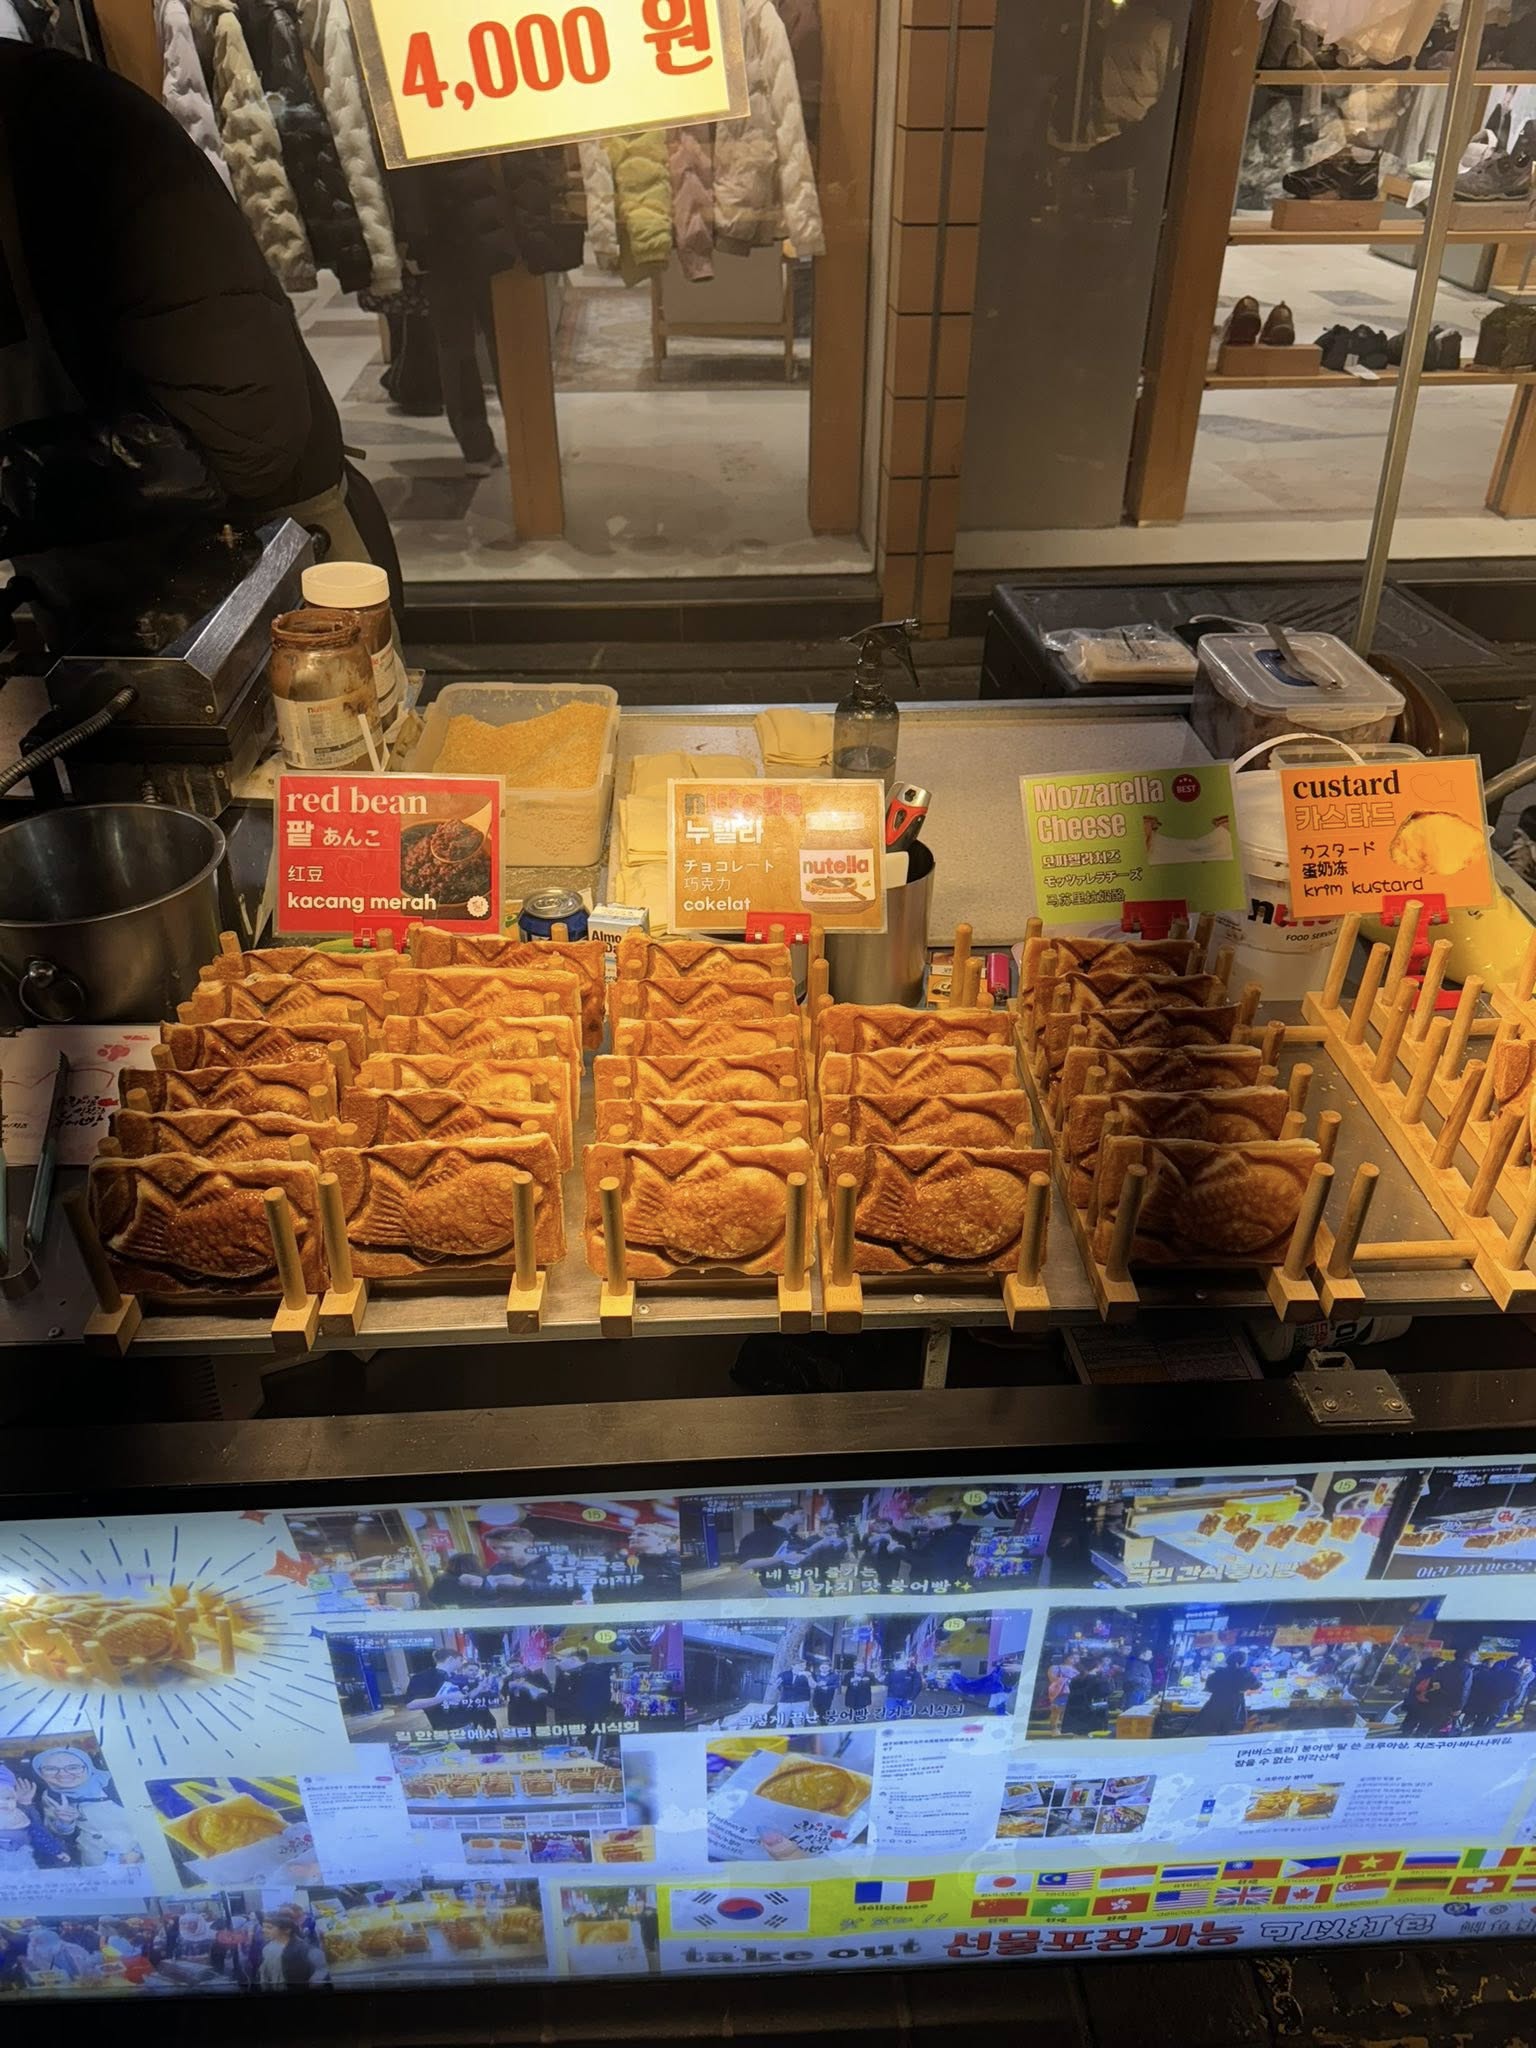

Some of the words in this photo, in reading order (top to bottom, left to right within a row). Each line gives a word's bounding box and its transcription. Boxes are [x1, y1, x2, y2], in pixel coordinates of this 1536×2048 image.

[402, 6, 611, 111] 4,000
[641, 0, 713, 75] 원
[1033, 776, 1165, 812] Mozzarella
[1176, 785, 1196, 794] BEST
[1293, 769, 1402, 800] custard
[286, 786, 340, 813] red
[350, 786, 428, 815] bean
[684, 787, 803, 817] nutella
[1295, 802, 1396, 831] 카스타드
[286, 820, 315, 847] 팥
[322, 828, 381, 847] あんこ
[686, 815, 764, 845] 누텔라
[1037, 813, 1127, 844] Cheese
[1301, 841, 1376, 859] カスタード
[287, 865, 324, 883] 红豆
[683, 859, 774, 874] チョコレート
[803, 855, 869, 874] nutella
[1302, 861, 1349, 879] 蛋奶冻
[683, 877, 731, 892] 巧克力
[1044, 867, 1144, 888] モッツァレラチーズ
[1304, 884, 1343, 898] krim
[1352, 877, 1424, 895] kustard
[287, 892, 365, 913] kacang
[370, 893, 437, 911] merah
[683, 896, 751, 912] cokelat
[592, 930, 621, 945] Almo
[547, 1570, 644, 1588] 처음이지?
[766, 1568, 782, 1581] 네
[788, 1567, 820, 1580] 명이
[1177, 1563, 1224, 1582] 간식
[786, 1581, 805, 1595] 네
[813, 1580, 854, 1595] 가지
[861, 1580, 881, 1593] 맛
[886, 1579, 952, 1594] 붕어빵
[789, 1711, 820, 1725] 끝난
[824, 1708, 870, 1723] 붕어빵
[920, 1704, 965, 1717] 시식회
[535, 1724, 587, 1738] 붕어빵
[591, 1720, 640, 1734] 시식회
[943, 1920, 1245, 1957] 선물포장가능
[1261, 1914, 1436, 1942] 可以打包
[681, 1946, 814, 1963] take
[827, 1938, 921, 1959] out
